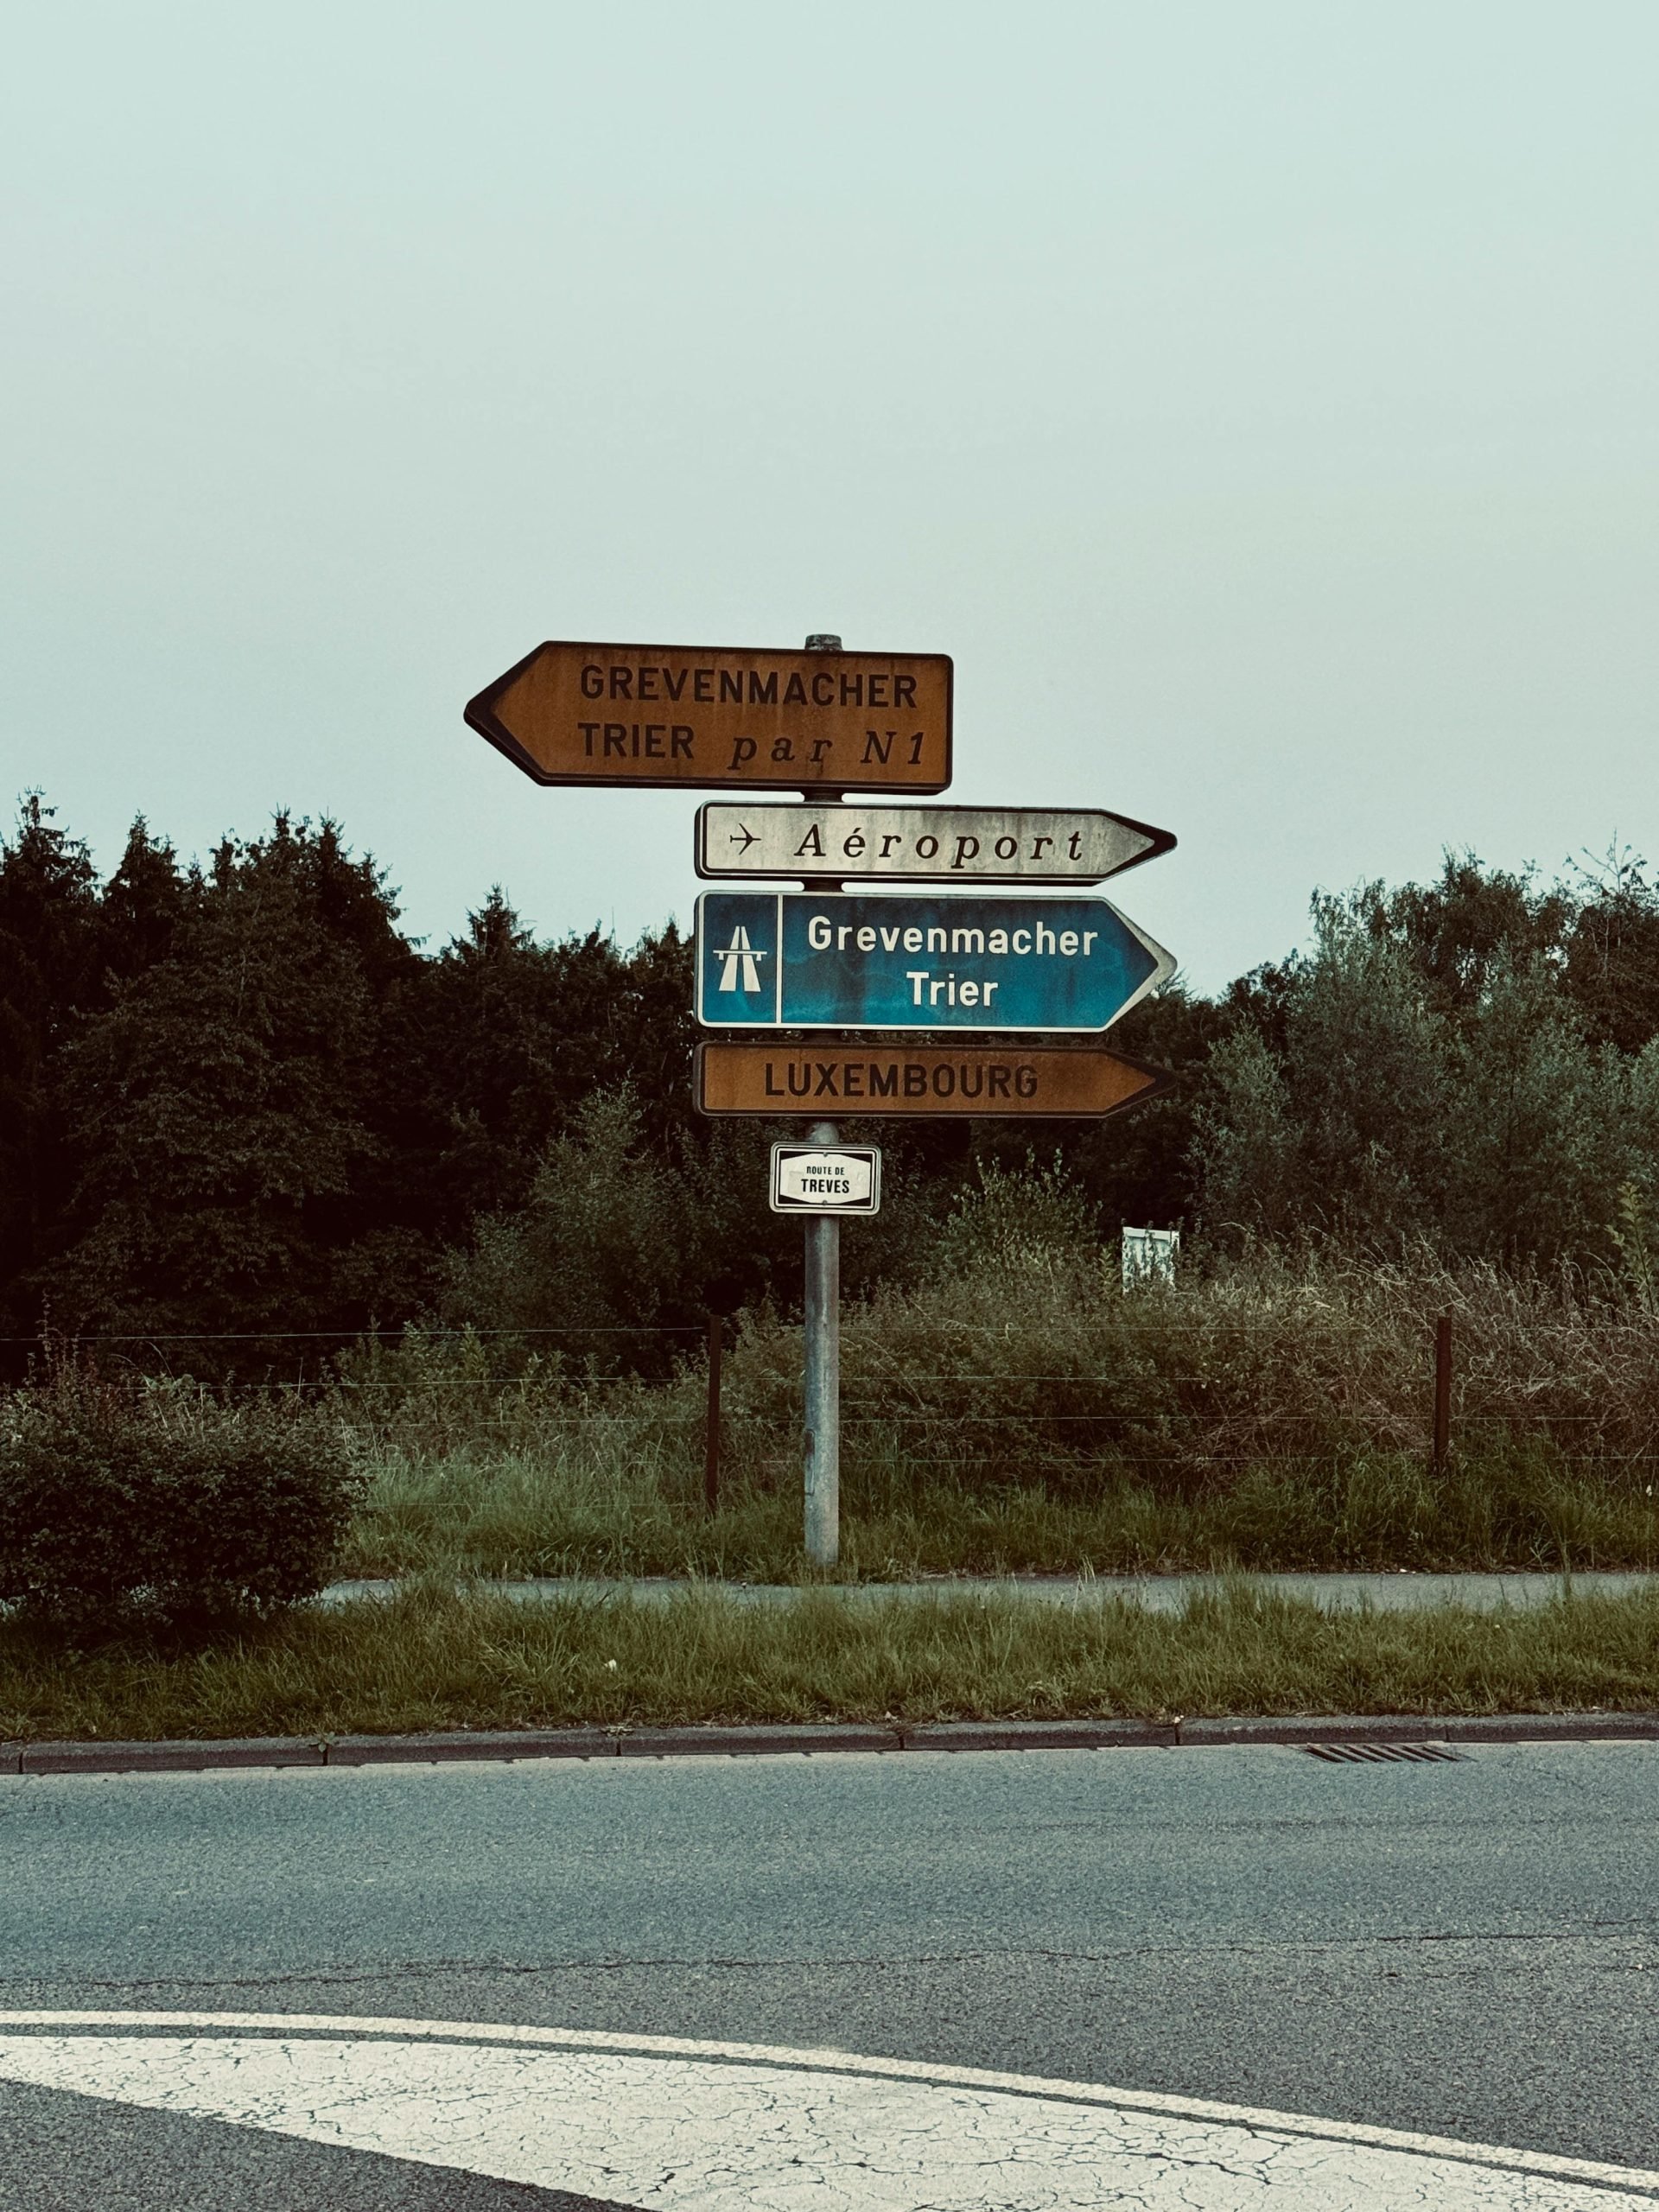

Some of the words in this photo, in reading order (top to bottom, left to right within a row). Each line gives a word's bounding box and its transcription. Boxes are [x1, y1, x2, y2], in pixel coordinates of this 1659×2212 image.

[580, 664, 918, 708] GREVENMACHER
[577, 722, 695, 760] TRIER
[727, 736, 833, 770] par
[861, 730, 925, 765] N1
[793, 823, 1084, 868] Aéroport
[807, 915, 1098, 956] Grevenmacher
[906, 971, 998, 1007] Trier
[765, 1062, 1039, 1098] LUXEMBOURG
[801, 1179, 850, 1193] TREVES
[806, 1166, 832, 1175] ROUTE
[835, 1166, 845, 1176] DE
